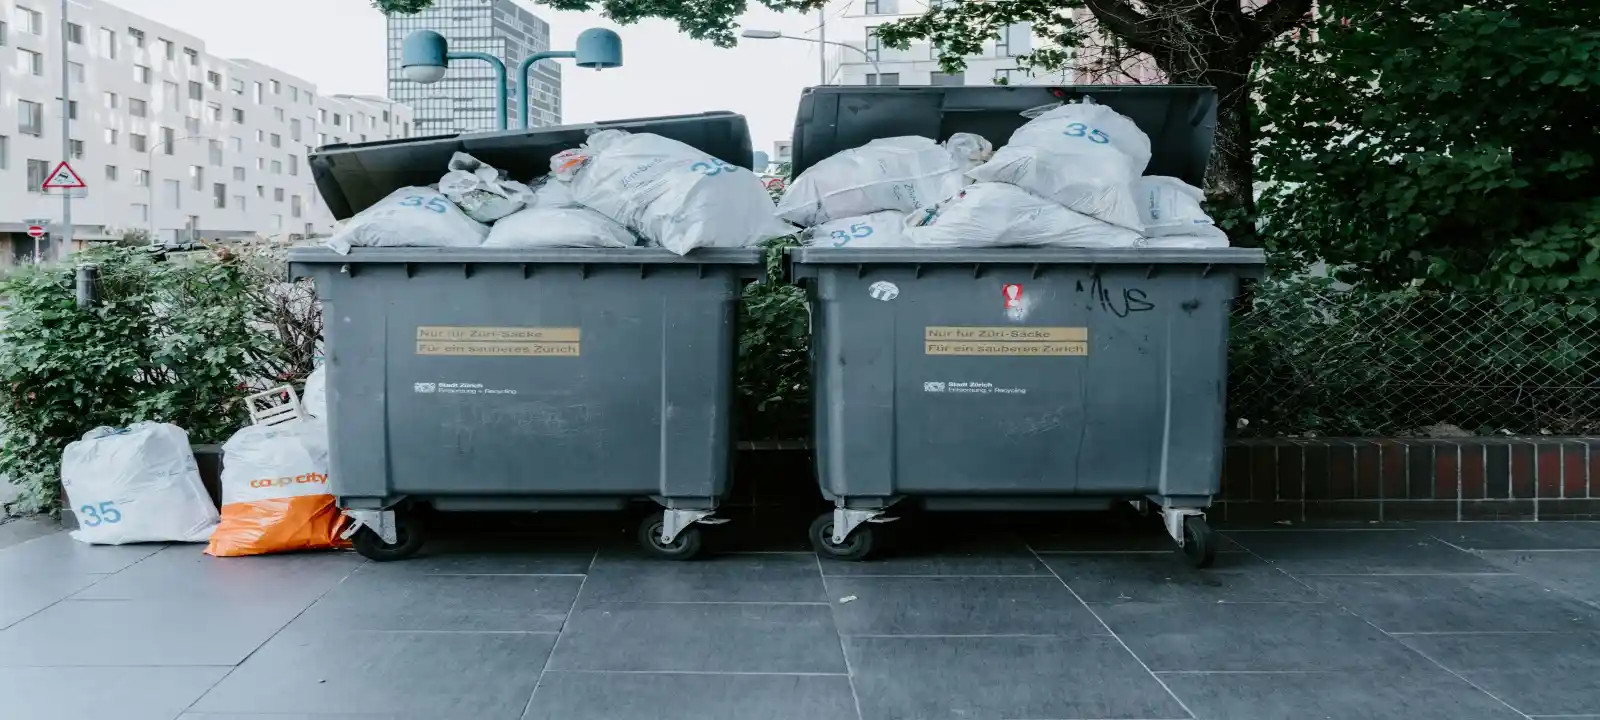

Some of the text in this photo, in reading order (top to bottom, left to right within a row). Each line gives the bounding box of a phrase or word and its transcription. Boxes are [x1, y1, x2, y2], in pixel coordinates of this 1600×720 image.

[1063, 122, 1110, 144] 35
[398, 195, 449, 214] 35
[830, 222, 874, 249] 35
[420, 329, 443, 338] Nur
[928, 329, 951, 338] Nur
[444, 344, 464, 353] ein
[953, 344, 973, 353] ein
[295, 471, 328, 484] city
[80, 501, 122, 527] 35
